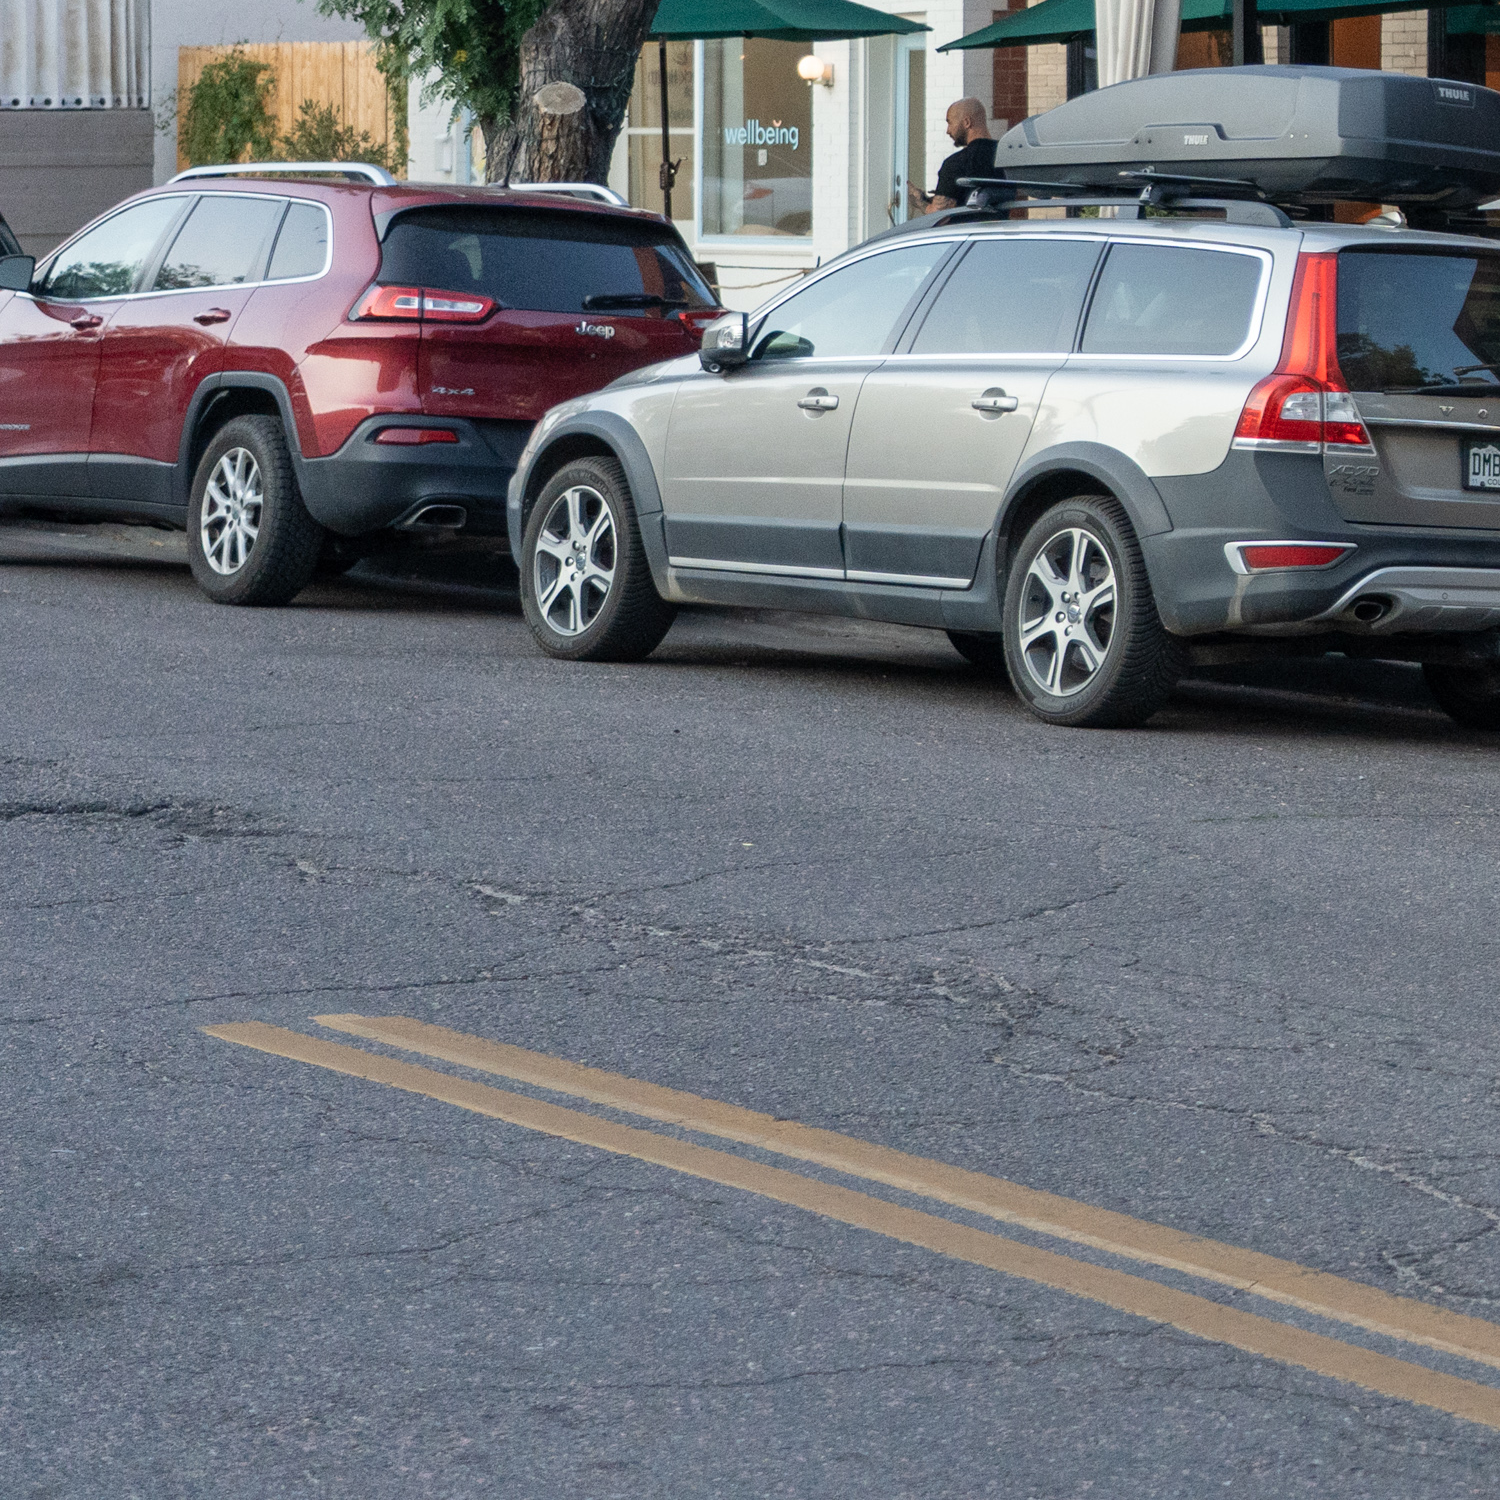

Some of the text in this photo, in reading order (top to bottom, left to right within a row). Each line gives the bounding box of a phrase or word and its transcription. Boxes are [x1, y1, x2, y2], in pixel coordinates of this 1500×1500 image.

[1438, 87, 1470, 101] THULE
[724, 119, 799, 151] wellbeing
[1184, 135, 1209, 146] THULE
[575, 320, 616, 340] Jeep
[431, 385, 476, 396] 4x4
